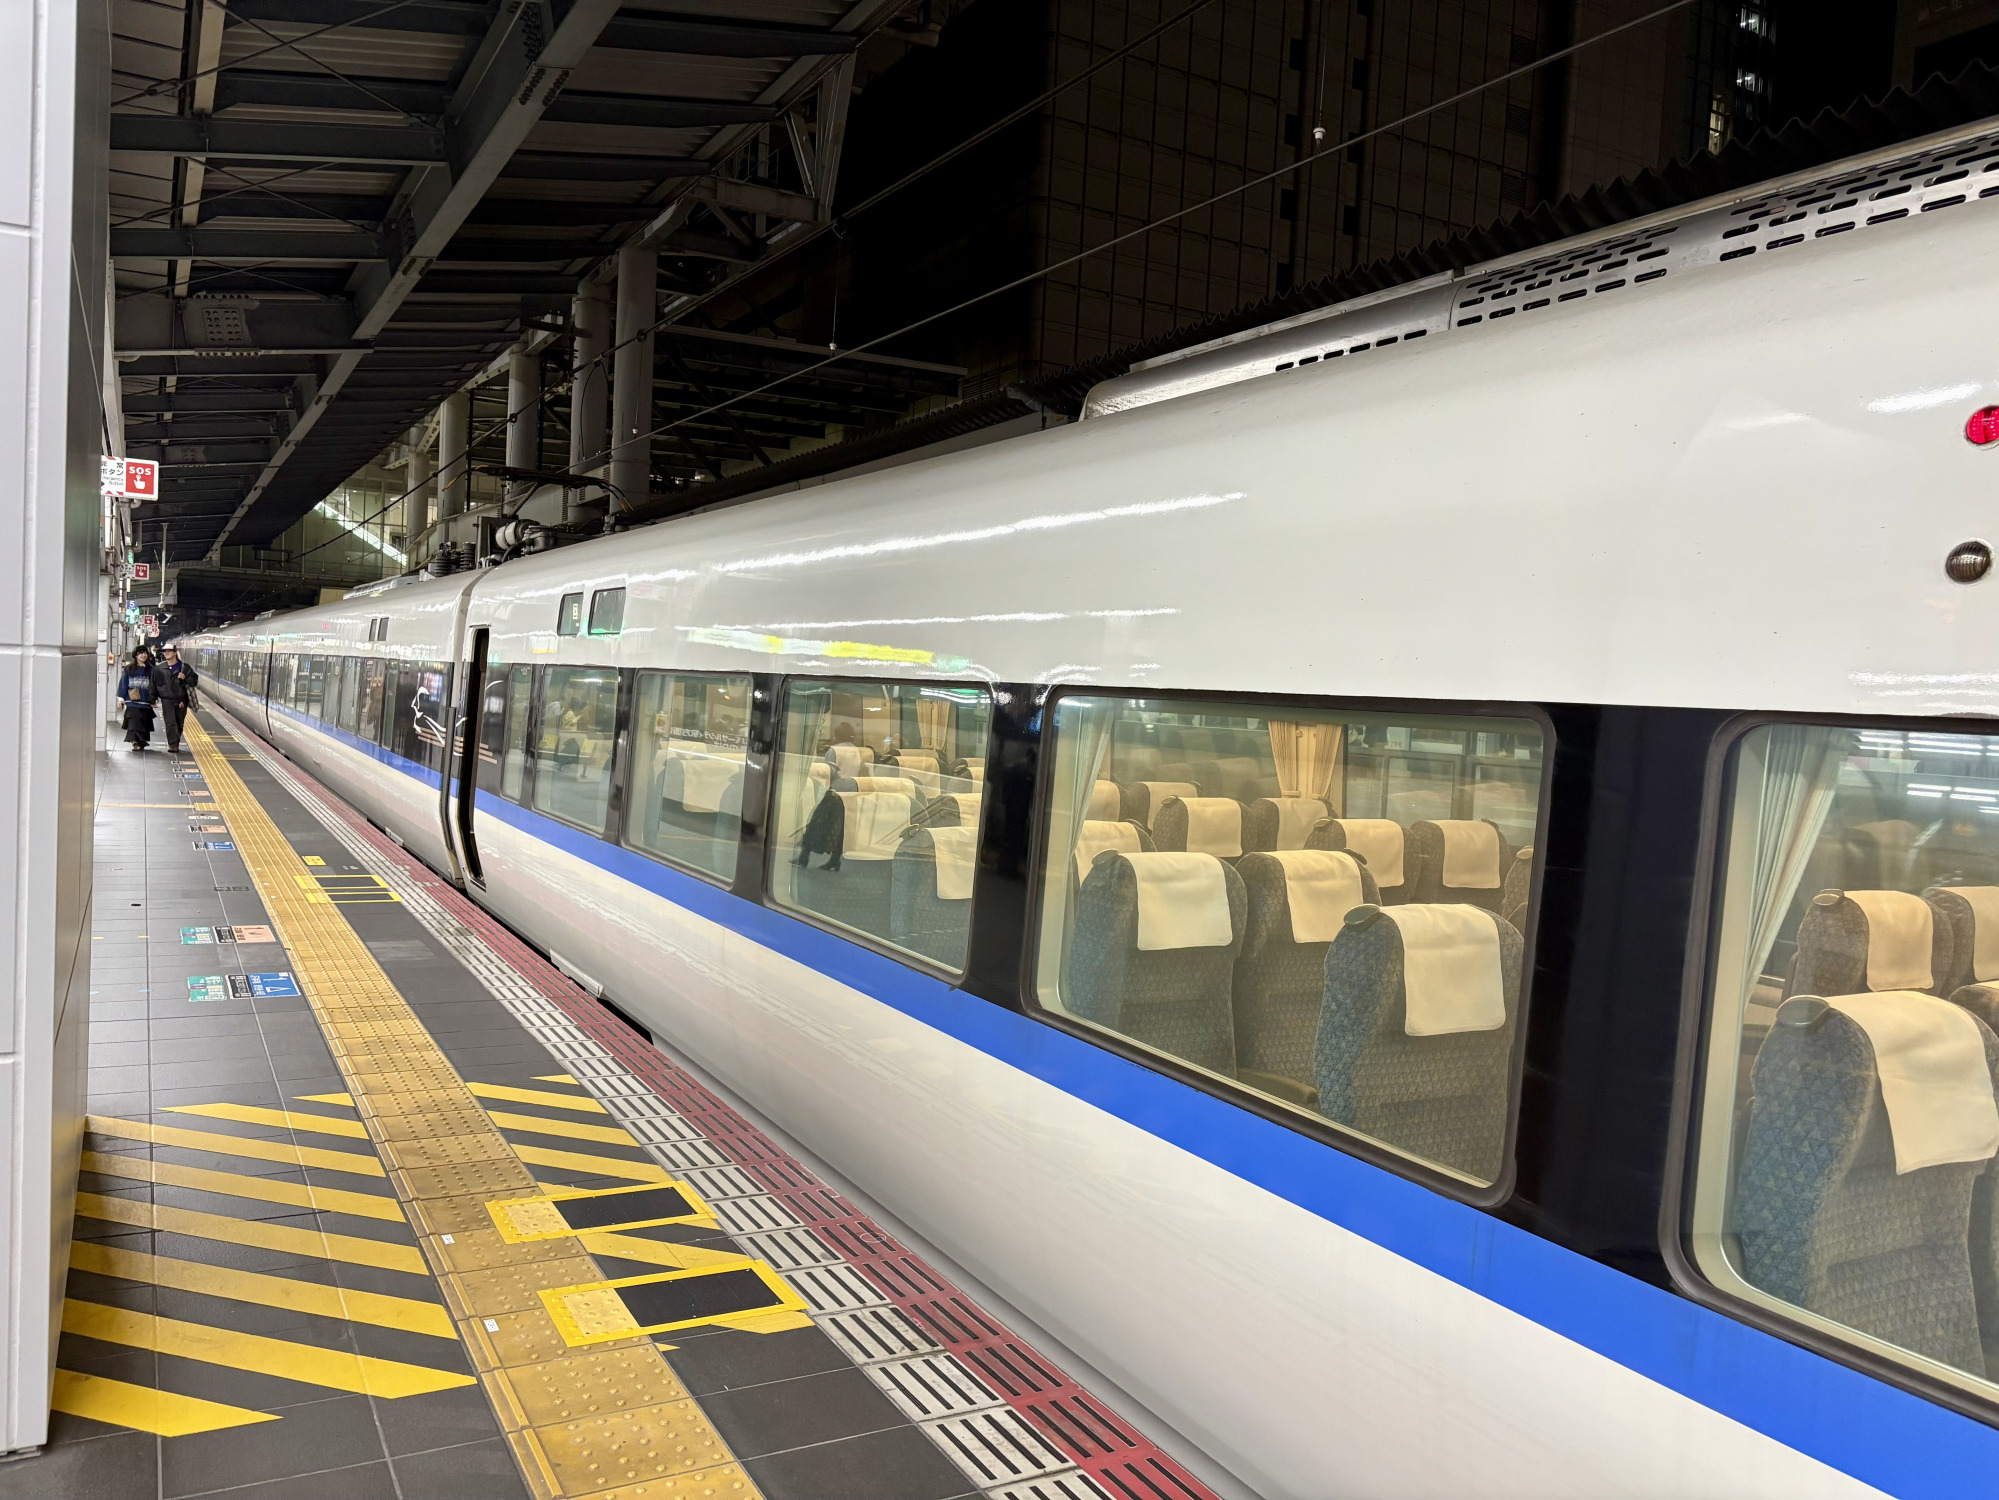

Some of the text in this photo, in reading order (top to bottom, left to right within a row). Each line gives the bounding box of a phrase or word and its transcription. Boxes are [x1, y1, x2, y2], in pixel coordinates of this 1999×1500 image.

[101, 468, 124, 476] ボタン
[129, 466, 152, 476] SOS
